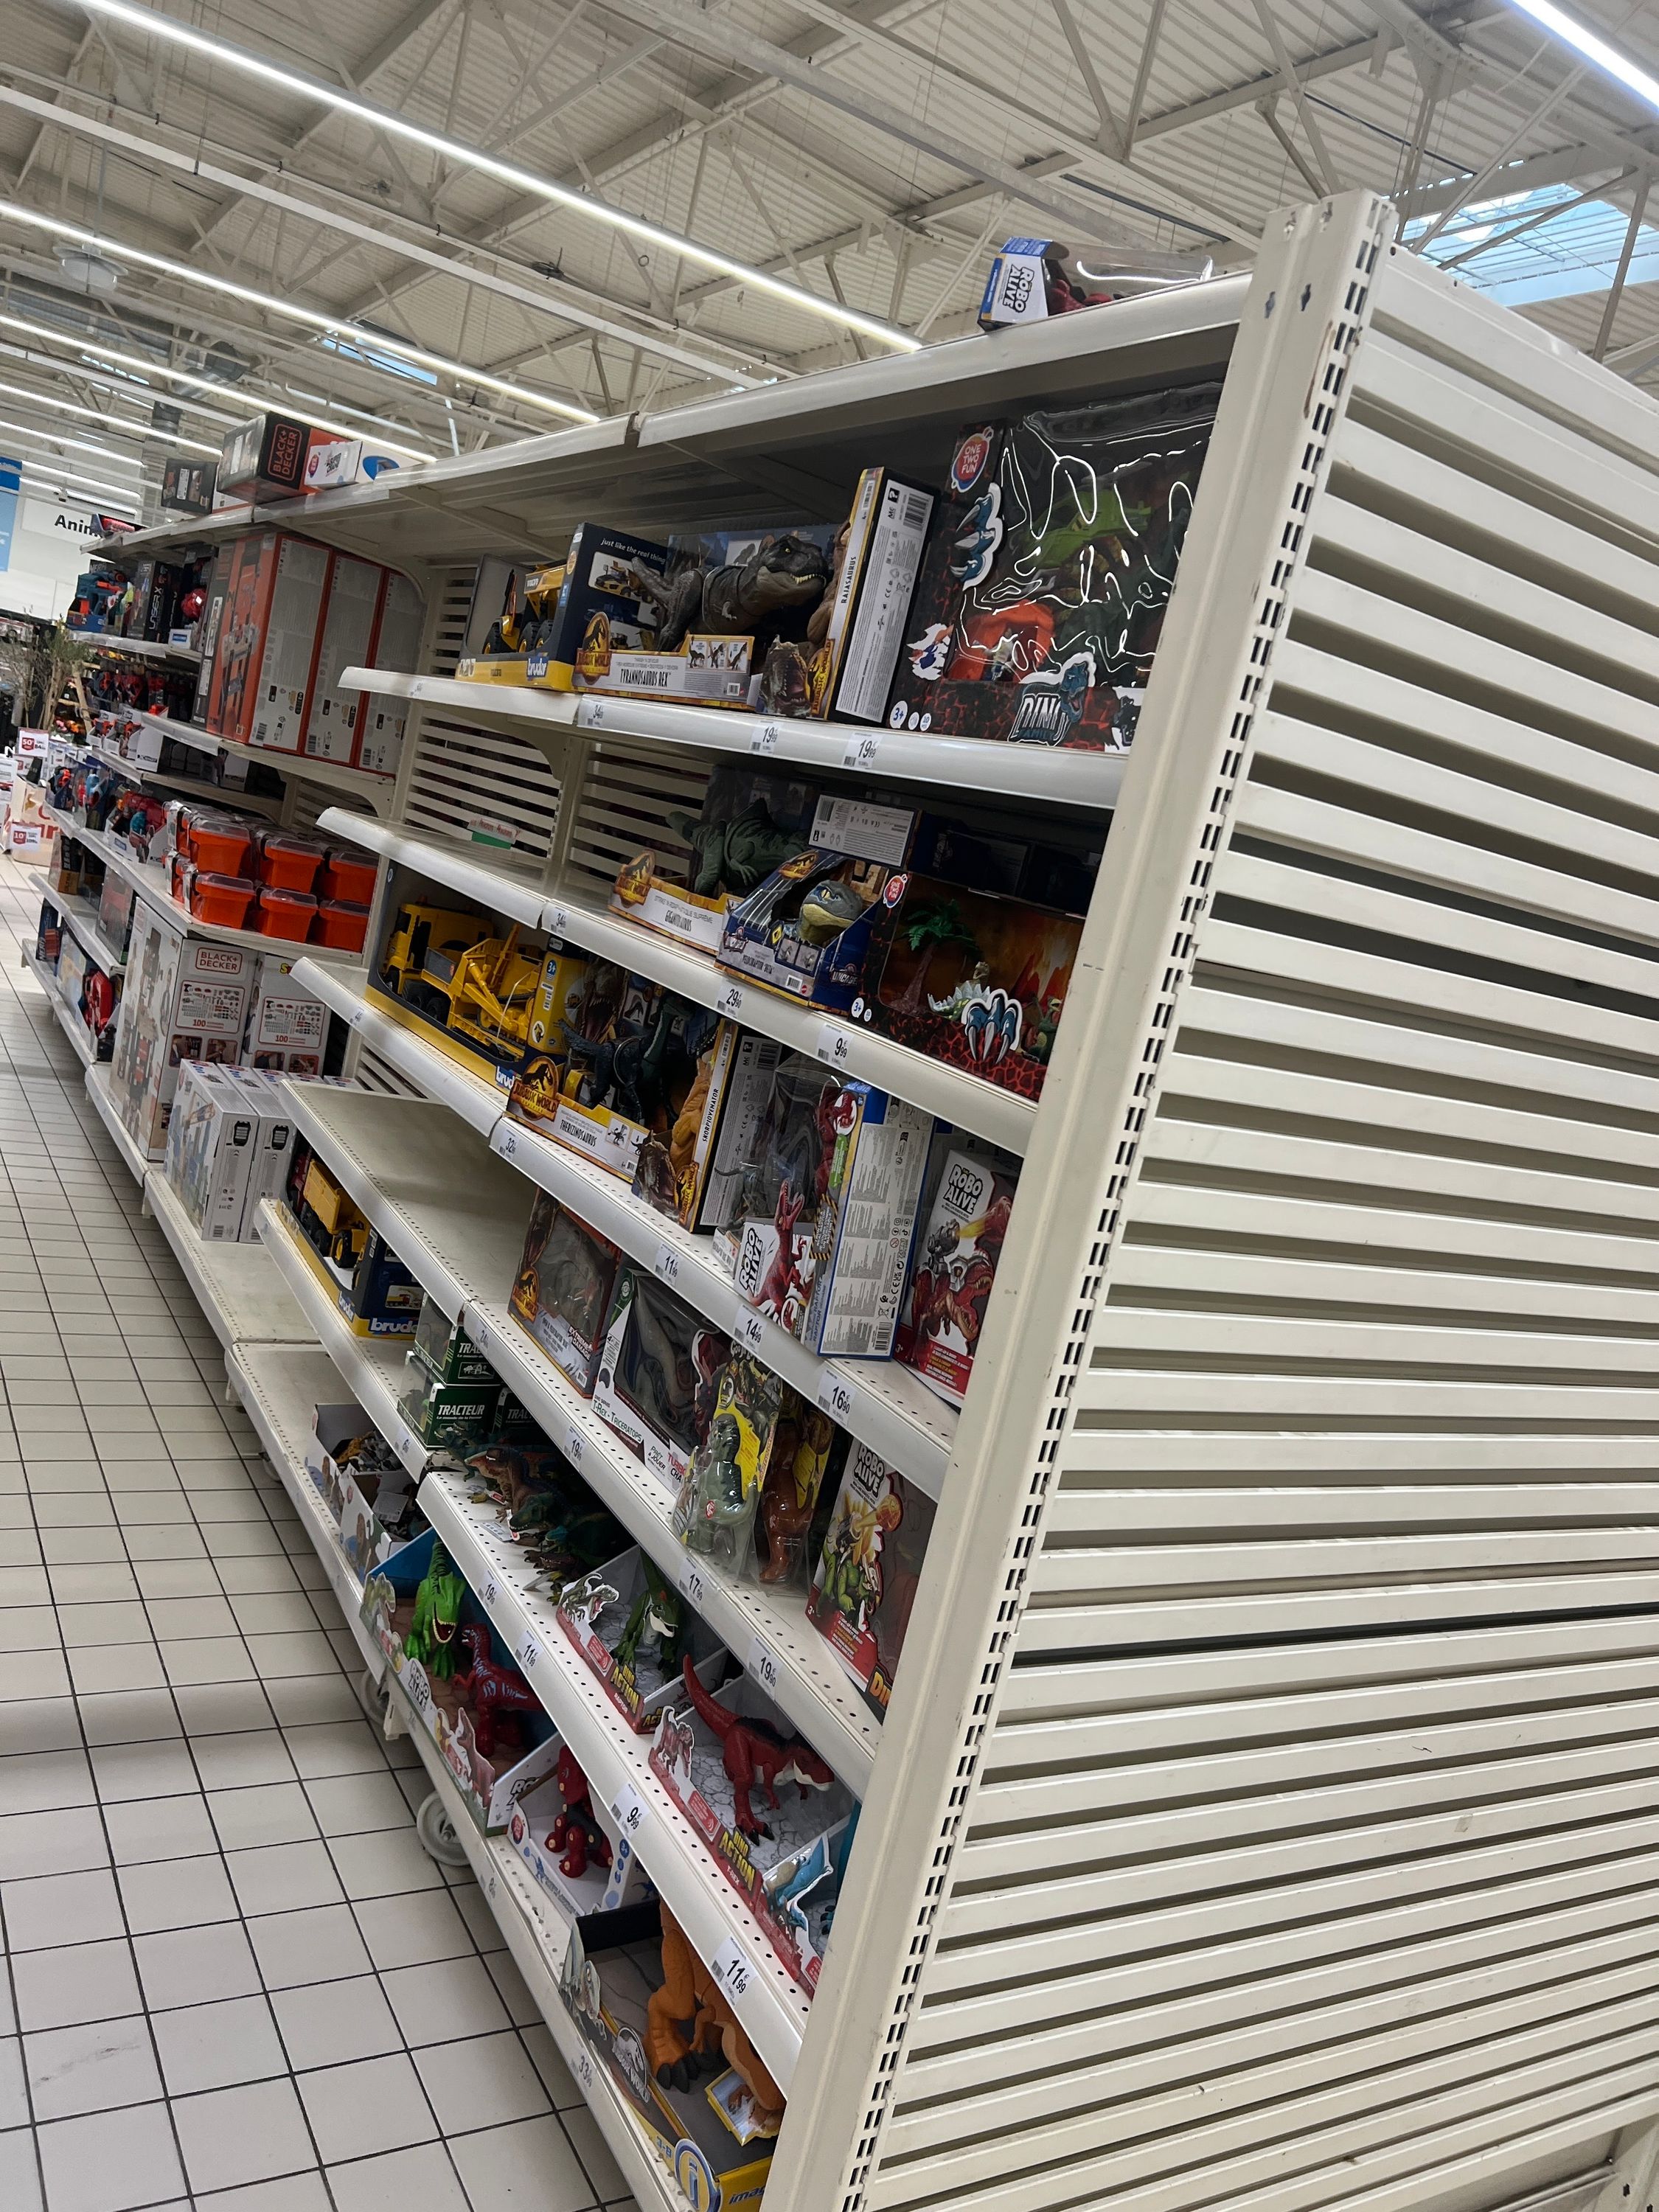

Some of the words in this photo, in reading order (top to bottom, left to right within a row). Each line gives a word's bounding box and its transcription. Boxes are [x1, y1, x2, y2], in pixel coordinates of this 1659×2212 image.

[1003, 264, 1021, 308] ALIVE
[1015, 267, 1034, 313] ROBO
[282, 431, 298, 476] DECKER
[963, 454, 978, 464] TWO
[964, 444, 981, 454] ONE
[961, 464, 978, 474] FUN
[55, 515, 95, 537] Ani
[601, 538, 614, 548] just
[615, 541, 626, 551] like
[627, 545, 637, 554] the
[637, 549, 650, 557] real
[620, 668, 658, 686] TYRANNOSAURUS
[658, 671, 669, 687] REX
[893, 709, 904, 721] 3+
[199, 959, 237, 971] DECKER
[201, 951, 237, 964] BLACK+
[548, 961, 556, 973] 3+
[854, 1002, 861, 1012] 3+
[703, 1088, 719, 1143] SKORPIOVENATOR
[949, 1164, 983, 1196] ROBO
[943, 1185, 978, 1215] ALIVE
[740, 1228, 757, 1290] ROBO
[748, 1235, 763, 1297] ALIVE
[438, 1405, 484, 1416] TRACTEUR
[858, 1443, 884, 1478] ROBO
[854, 1461, 880, 1498] ALIVE
[411, 1660, 429, 1699] ROBO
[611, 1666, 639, 1714] ACTION
[408, 1680, 427, 1713] ALIVE
[734, 1832, 749, 1857] DINO
[719, 1831, 755, 1892] ACTION
